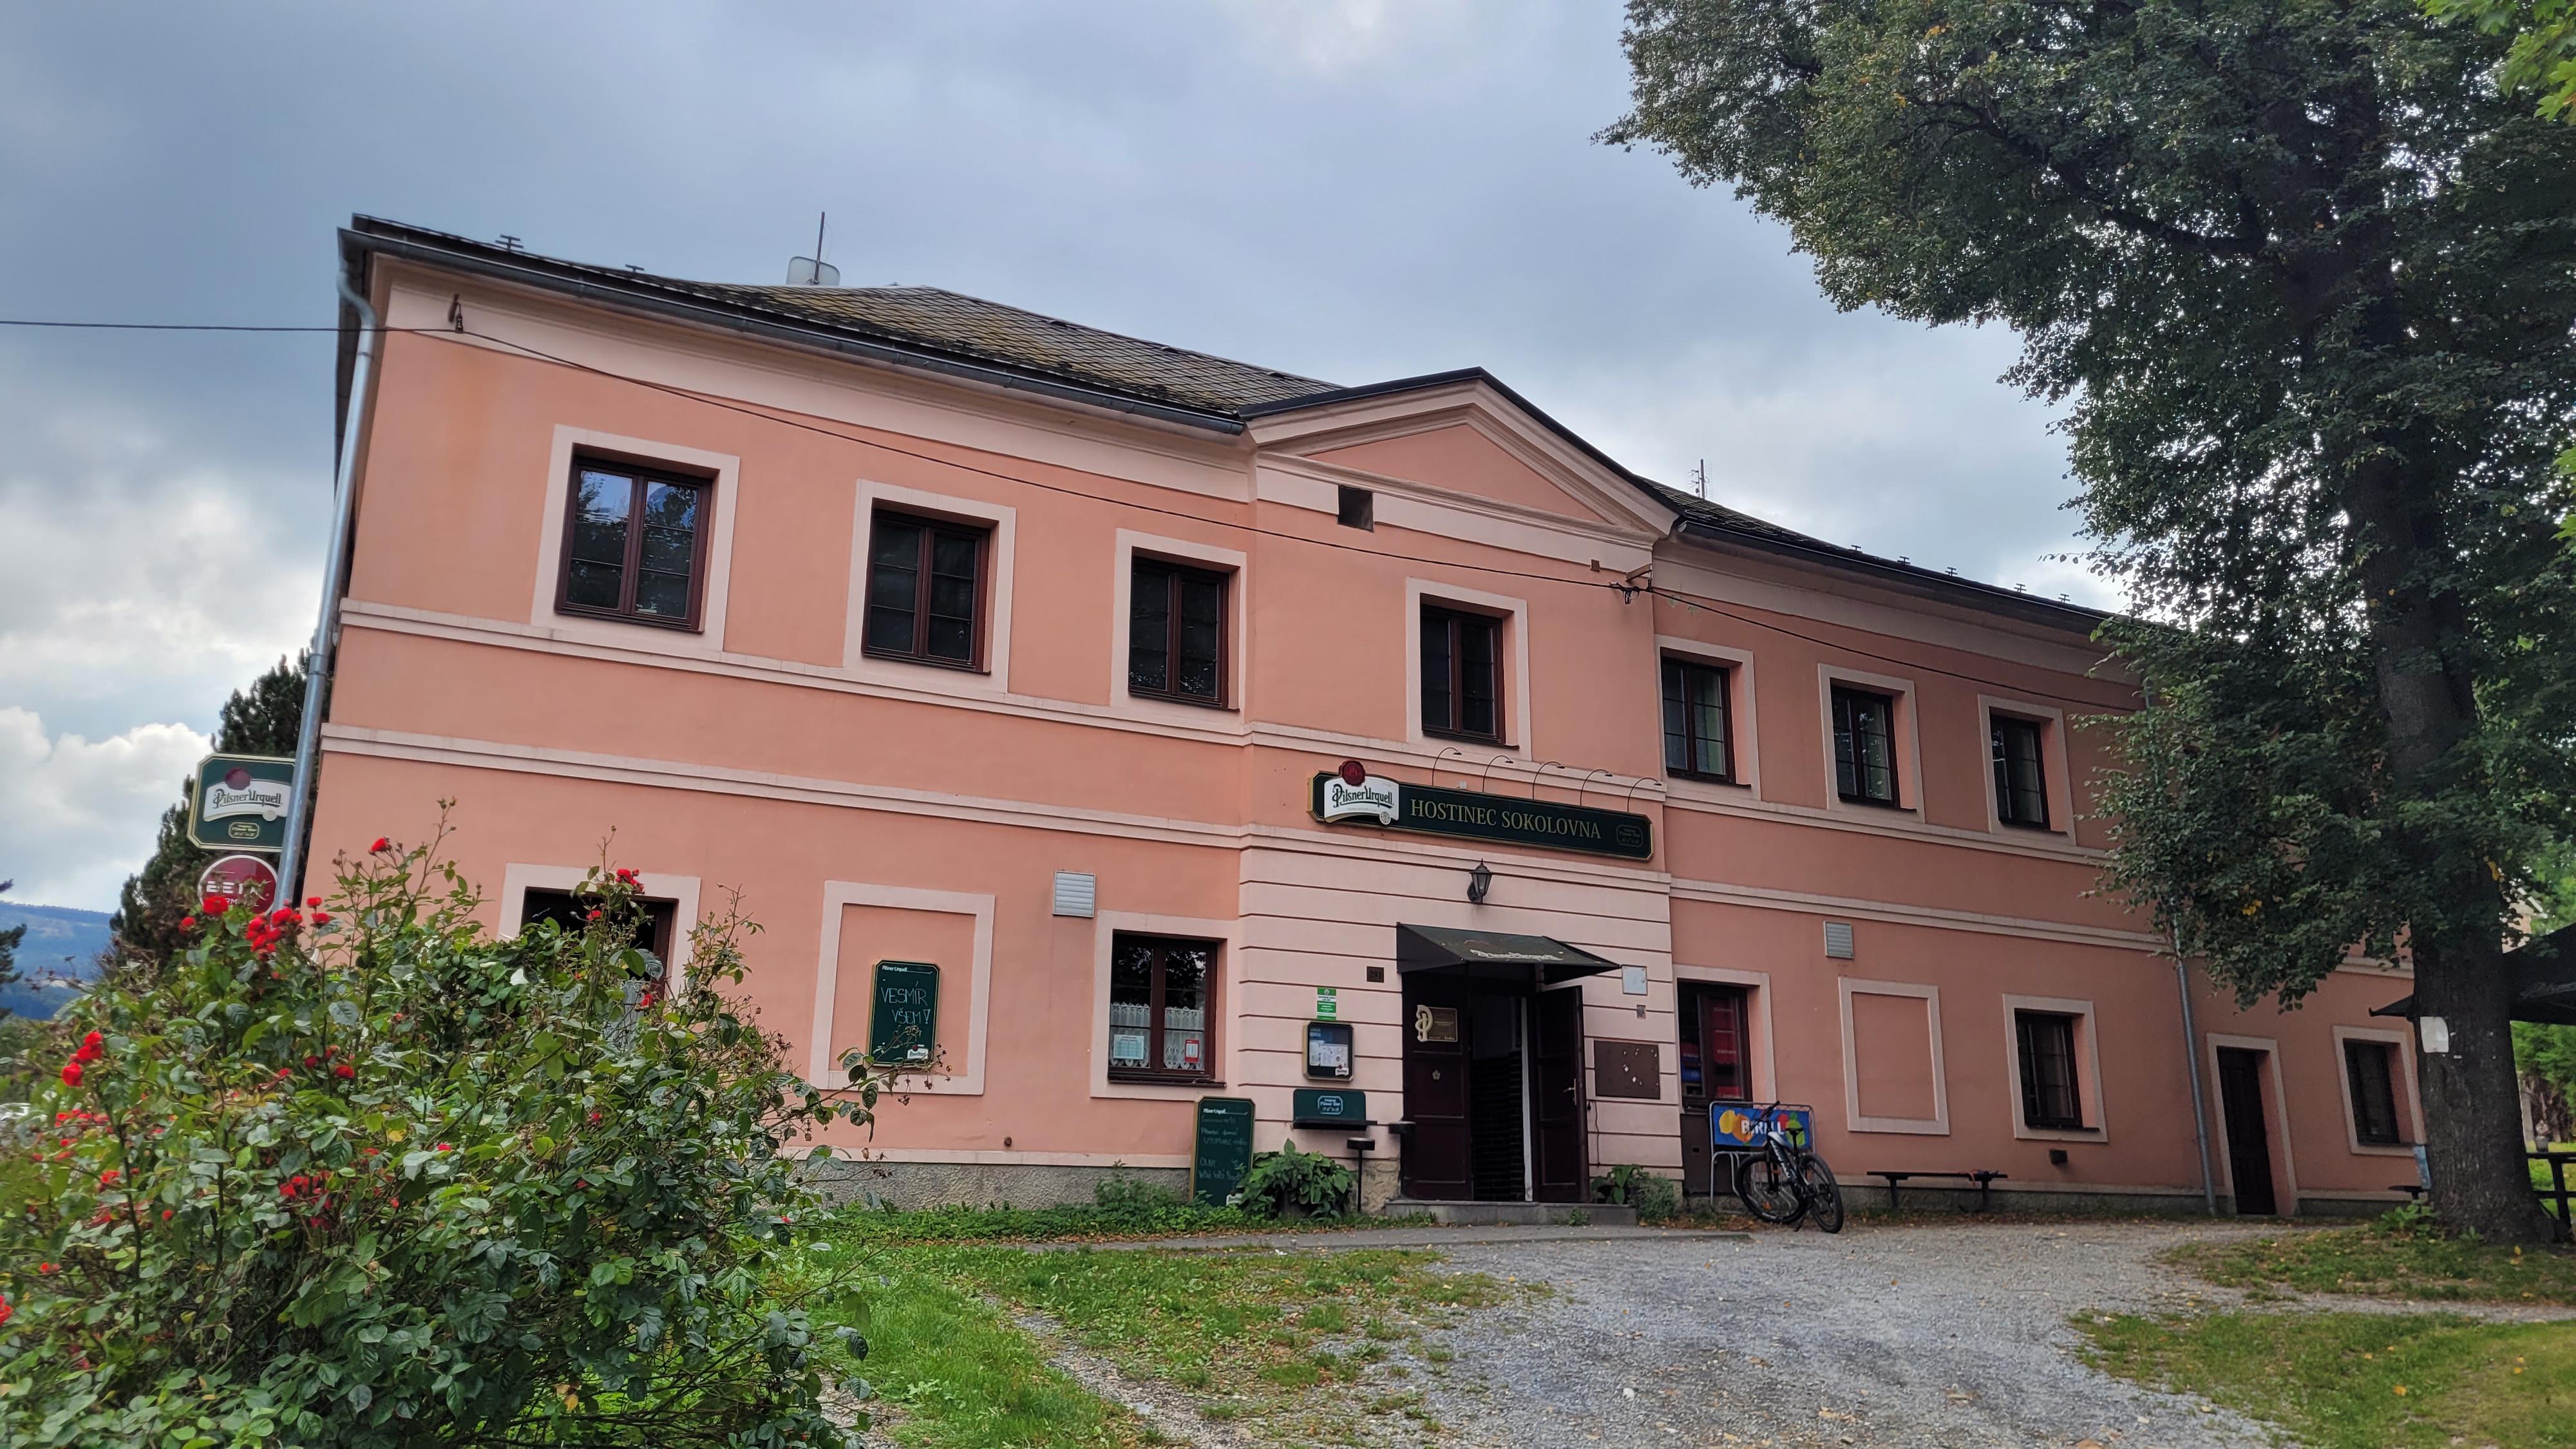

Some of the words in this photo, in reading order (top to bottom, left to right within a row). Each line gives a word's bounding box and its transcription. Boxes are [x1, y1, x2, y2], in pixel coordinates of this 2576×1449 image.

[213, 788, 250, 809] Pilsner
[248, 789, 282, 807] Urquell
[1332, 783, 1365, 808] Pilsner
[1364, 785, 1393, 808] Urquell
[1410, 799, 1497, 826] HOSTINEC
[1501, 811, 1602, 839] SOKOLOVNA
[880, 980, 928, 1007] VESMÍR
